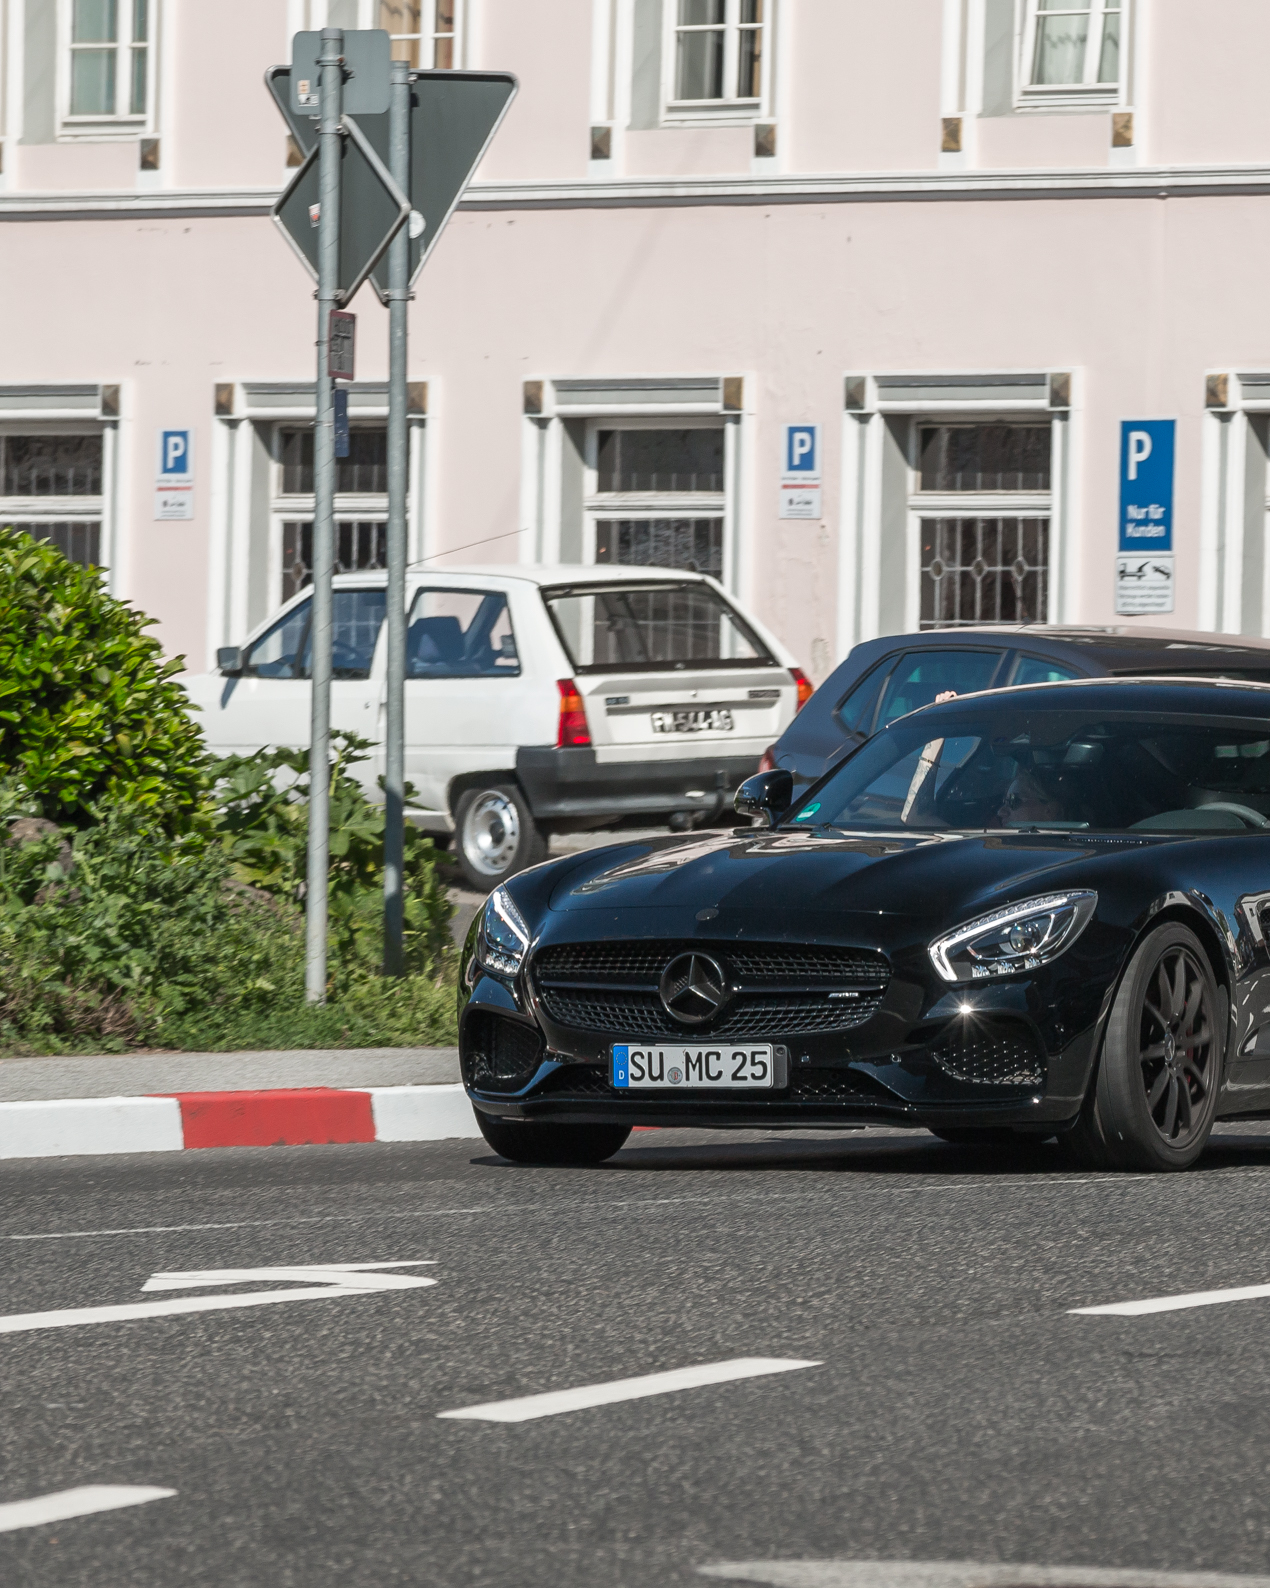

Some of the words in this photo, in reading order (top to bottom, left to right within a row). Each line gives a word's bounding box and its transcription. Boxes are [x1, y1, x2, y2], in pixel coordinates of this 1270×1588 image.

[166, 435, 185, 469] P
[792, 432, 812, 466] P
[1127, 430, 1153, 481] P
[1126, 504, 1148, 520] Nur
[1148, 503, 1166, 520] für
[1125, 522, 1166, 538] Kunden
[630, 1051, 664, 1082] SU
[685, 1051, 723, 1081] MC
[731, 1051, 768, 1081] 25
